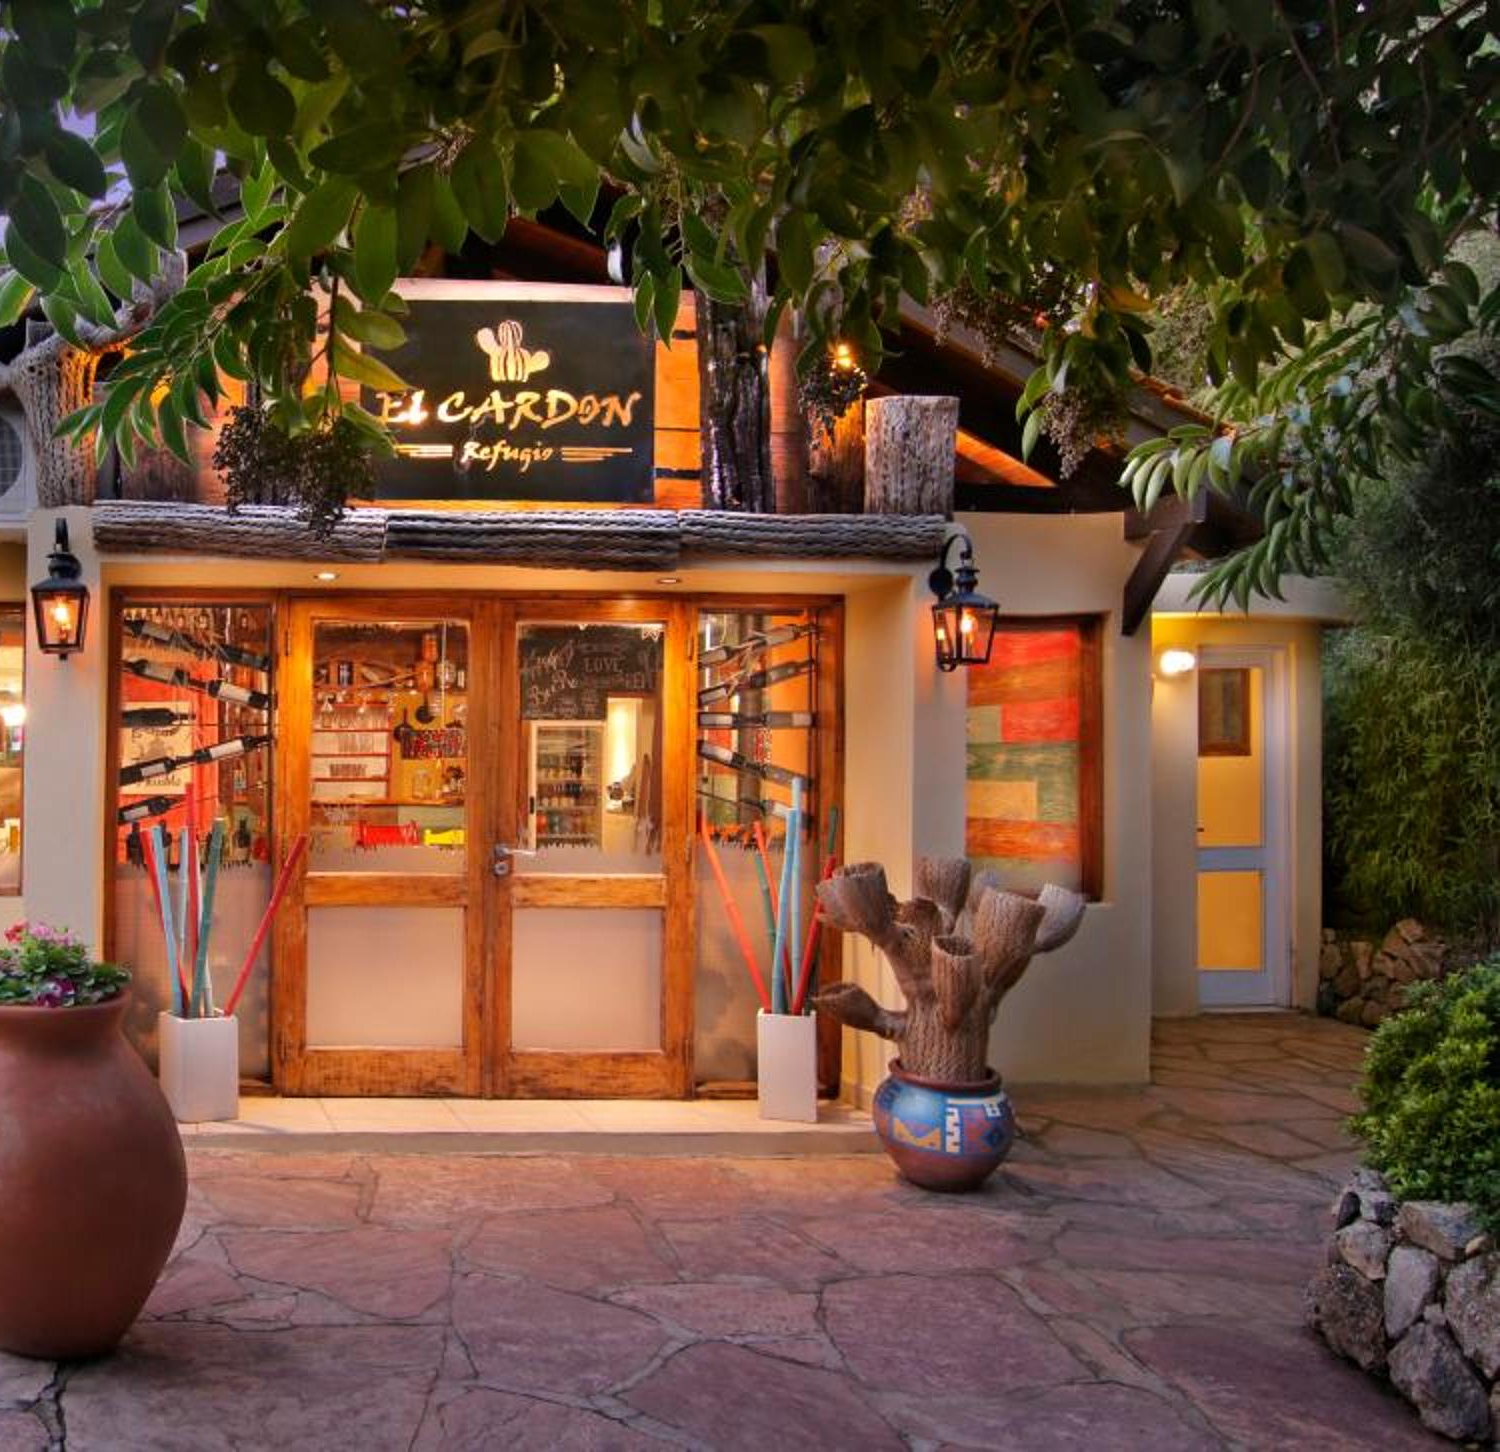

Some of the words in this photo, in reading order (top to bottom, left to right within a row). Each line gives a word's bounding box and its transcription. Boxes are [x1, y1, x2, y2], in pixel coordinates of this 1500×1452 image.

[437, 389, 642, 430] CARDON
[460, 439, 554, 472] Refugio
[583, 656, 623, 673] LOVE
